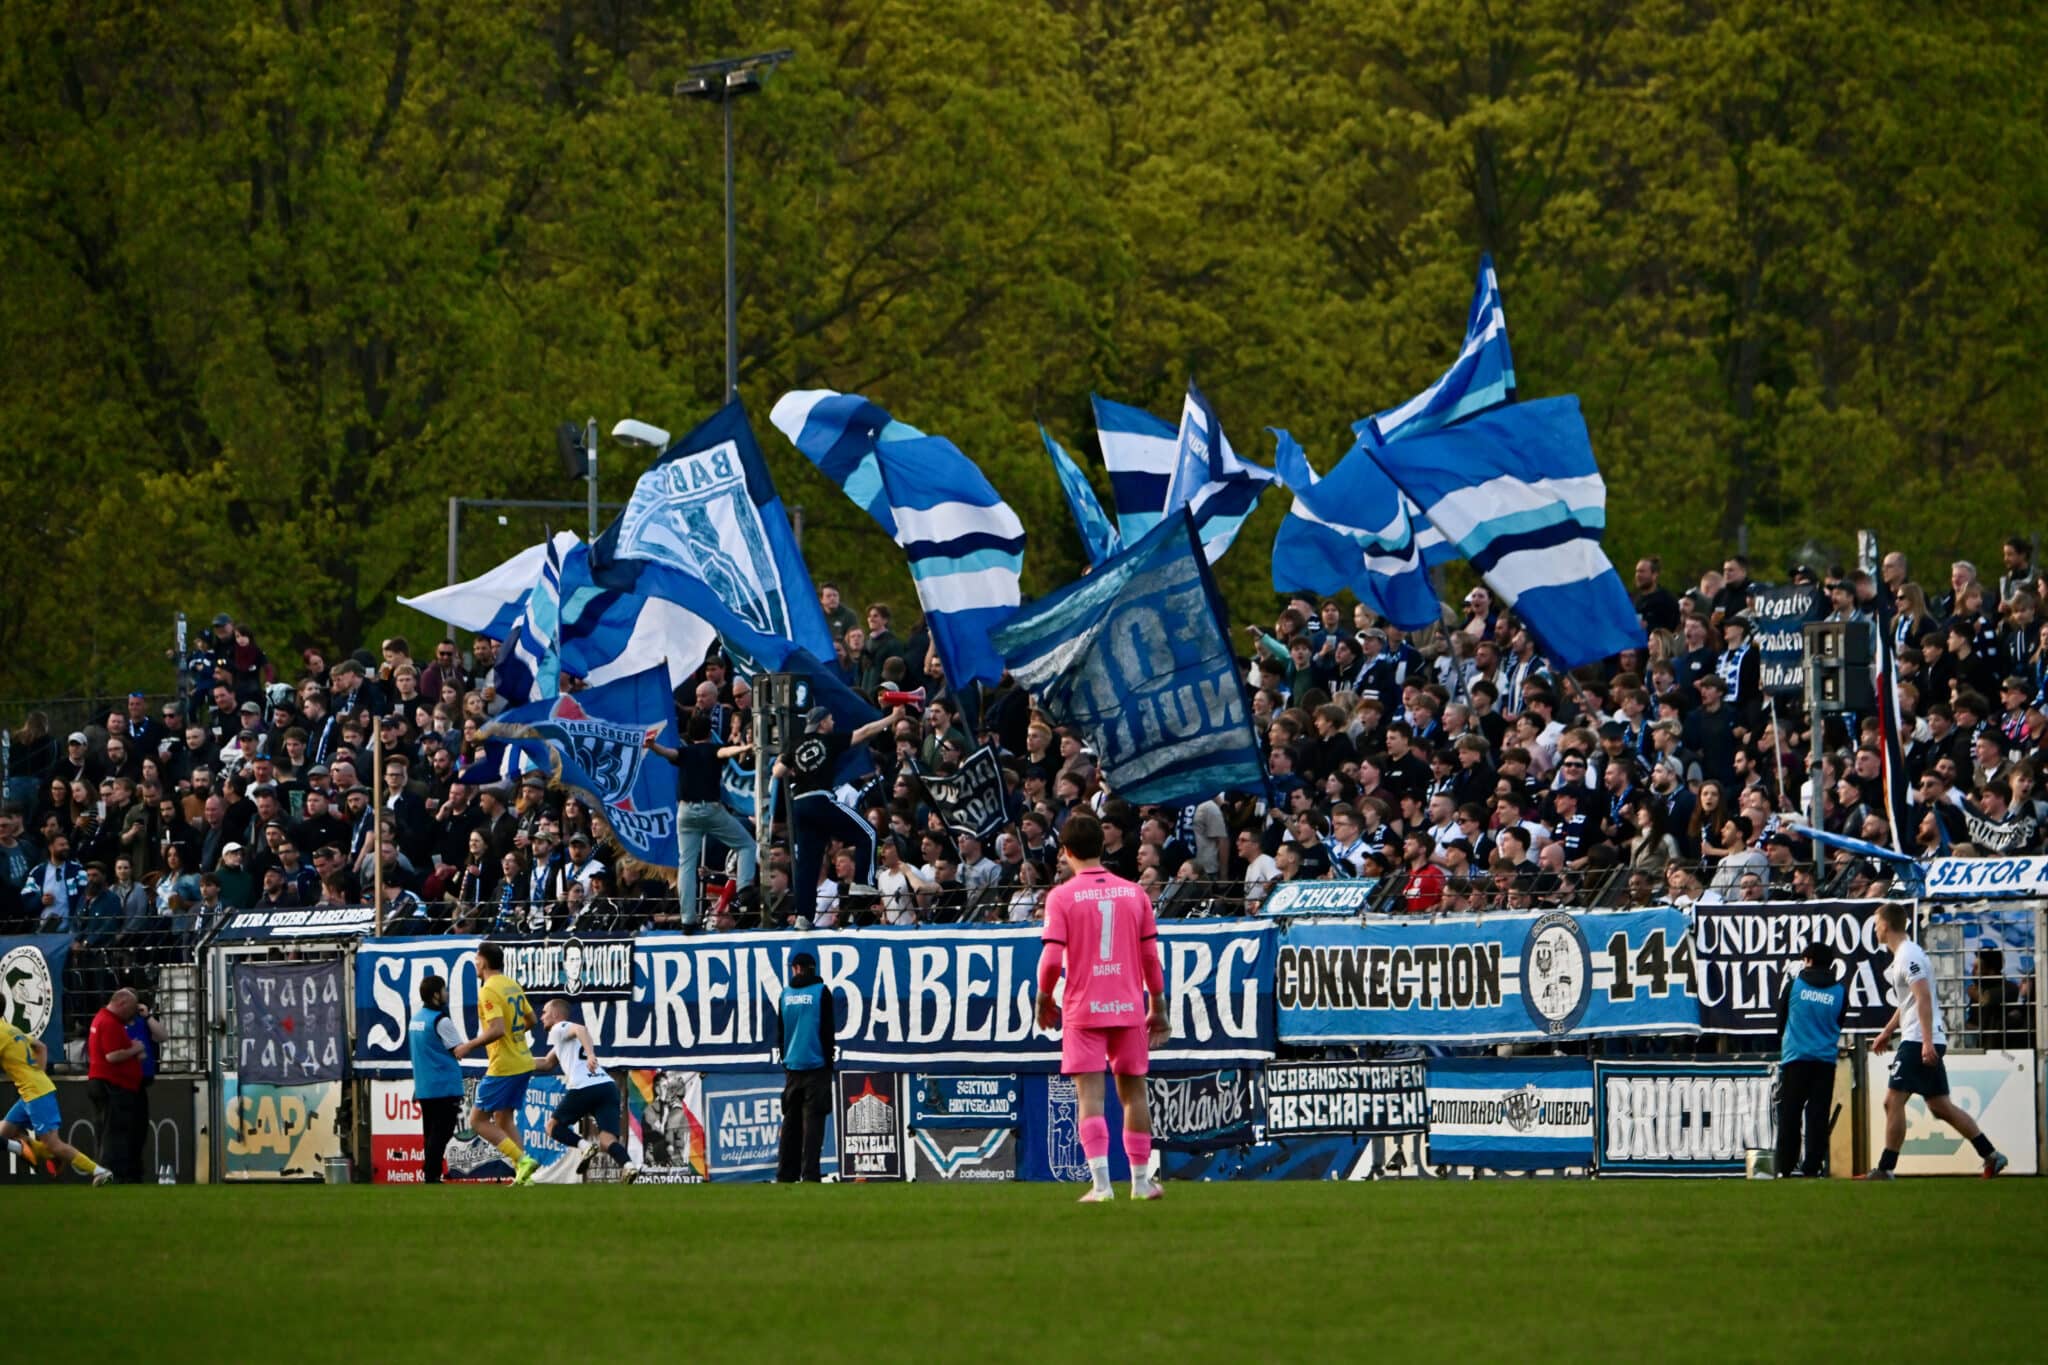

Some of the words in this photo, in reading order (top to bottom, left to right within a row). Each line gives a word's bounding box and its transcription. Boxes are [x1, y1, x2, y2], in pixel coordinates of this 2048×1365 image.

[1930, 858, 2032, 887] SEKTOR
[1074, 886, 1136, 902] BABELSBERG
[1098, 900, 1114, 961] 1
[1696, 913, 1912, 955] UNDERDOG
[584, 944, 630, 988] YOUTH
[1277, 943, 1502, 1010] CONNECTION
[367, 946, 795, 1054] SPOVEREIN
[816, 938, 1261, 1044] BABELRG
[1090, 1001, 1134, 1015] Katjes
[1800, 989, 1835, 1005] ORDNER
[1268, 1064, 1424, 1092] VERBANDSSTRAFEN
[385, 1093, 422, 1120] Uns
[526, 1088, 547, 1105] STILL
[1269, 1091, 1425, 1129] ABSCHAFFEN!
[226, 1096, 306, 1155] SAP
[720, 1097, 785, 1128] ALER
[1538, 1101, 1591, 1126] JUGEND
[719, 1125, 783, 1148] NETW
[845, 1136, 896, 1153] ESTRELLA
[387, 1147, 408, 1160] Min
[387, 1169, 414, 1182] Meine
[960, 1169, 1004, 1179] babelsberg
